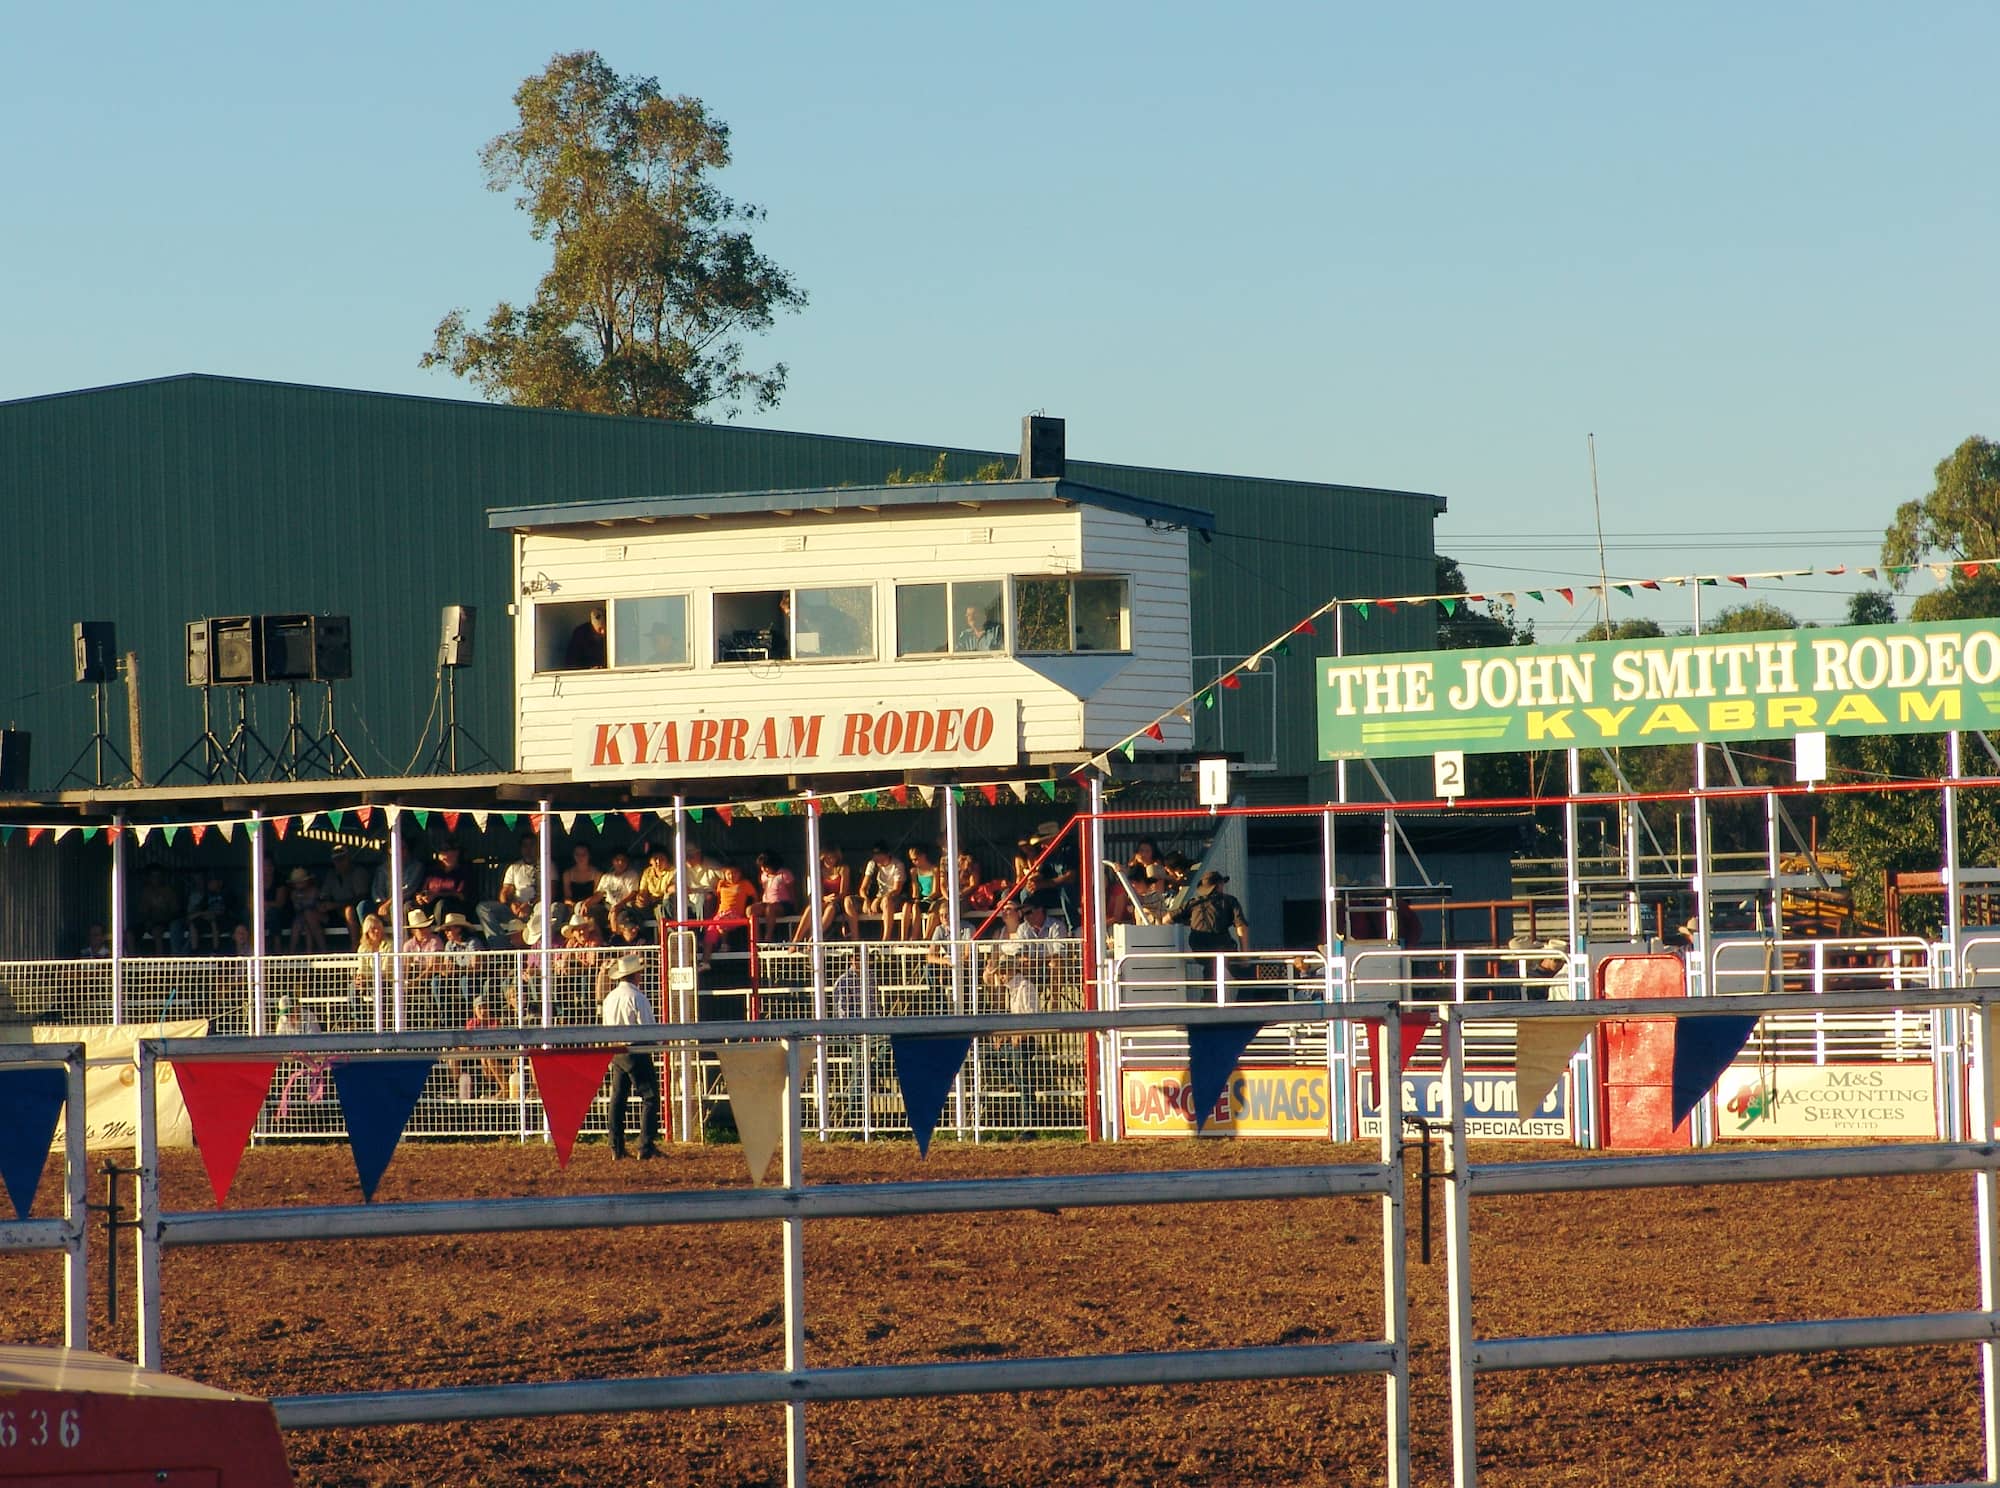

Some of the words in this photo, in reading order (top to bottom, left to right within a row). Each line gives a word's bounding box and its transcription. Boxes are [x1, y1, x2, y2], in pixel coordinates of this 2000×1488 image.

[1327, 661, 1435, 716] THE
[1448, 653, 1596, 711] JOHN
[1612, 640, 1799, 702] SMITH
[1811, 631, 2000, 692] RODEO
[1527, 689, 1962, 741] KYABRAM
[590, 715, 826, 767] KYABRAM
[839, 706, 994, 757] RODEO
[1441, 760, 1459, 785] 2
[1826, 1071, 1883, 1087] M&S
[1129, 1079, 1230, 1122] DARCE
[1233, 1078, 1326, 1122] SWAGS
[1780, 1089, 1928, 1104] ACCOUNTING
[1804, 1106, 1905, 1122] SERVICES
[1463, 1122, 1564, 1136] SPECIALISTS
